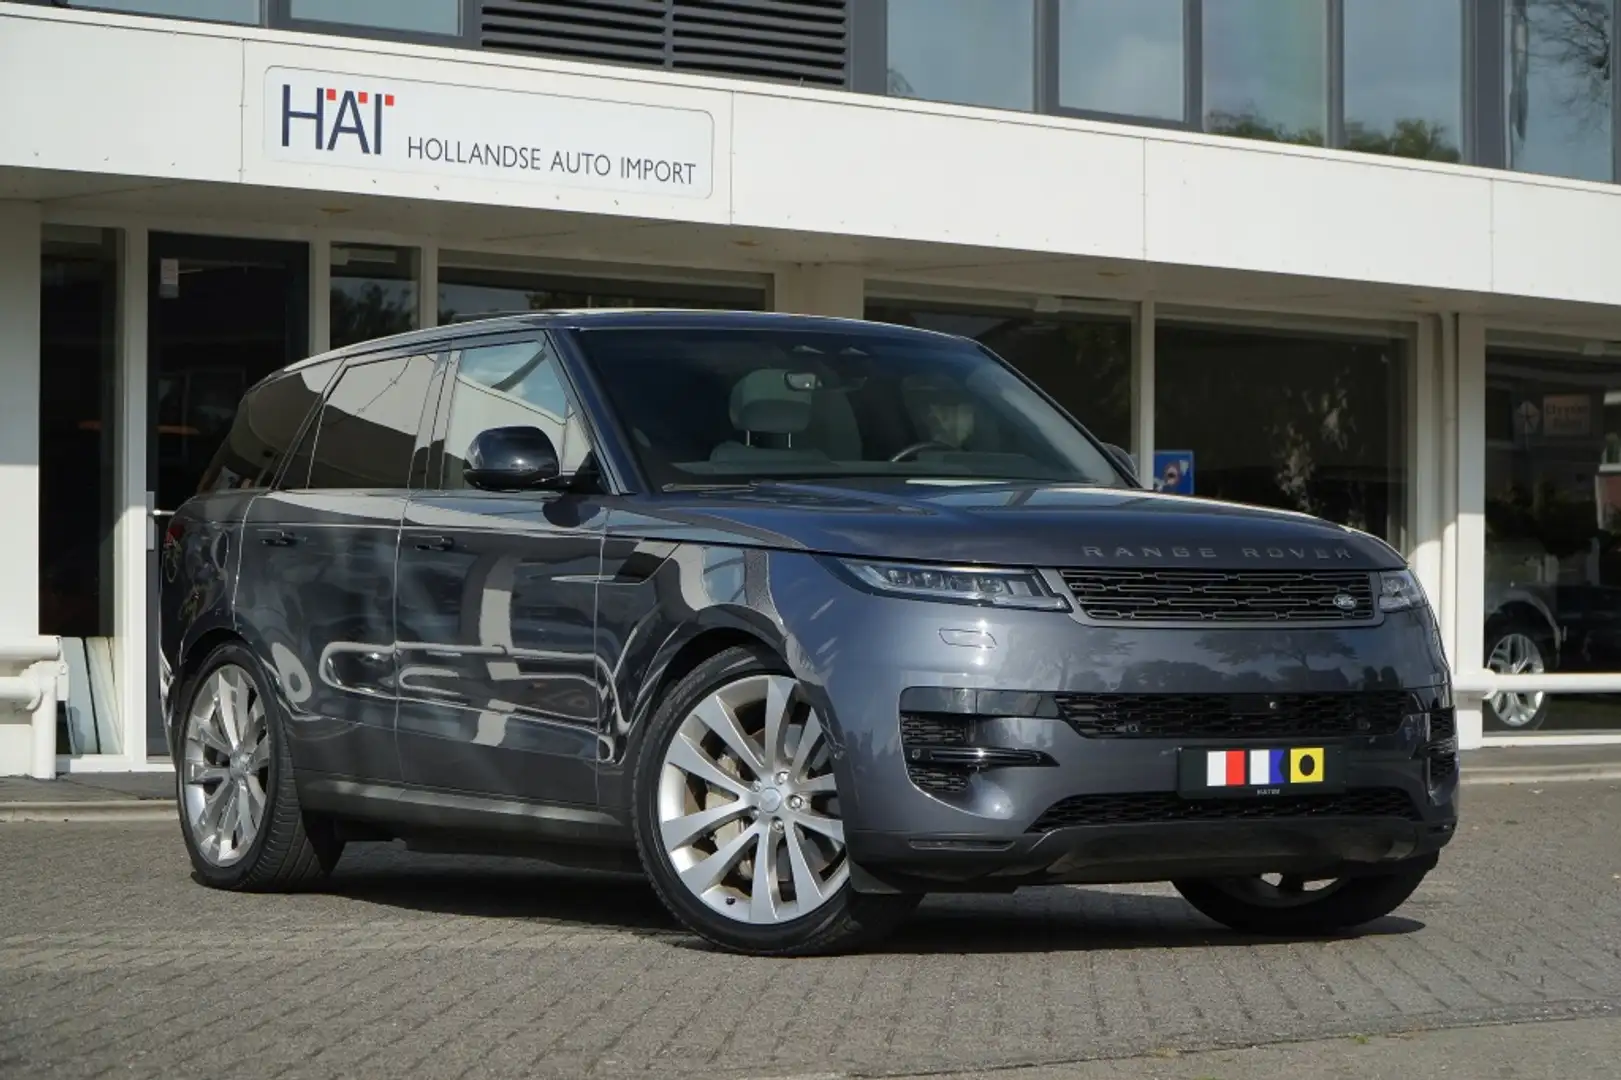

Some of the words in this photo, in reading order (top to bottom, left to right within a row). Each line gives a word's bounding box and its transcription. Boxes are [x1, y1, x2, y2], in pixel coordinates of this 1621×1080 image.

[407, 136, 541, 170] HOLLANDSE
[550, 150, 611, 176] AUTO
[620, 156, 696, 184] IMPORT
[1082, 545, 1217, 558] RANGE
[1242, 548, 1352, 559] ROVER
